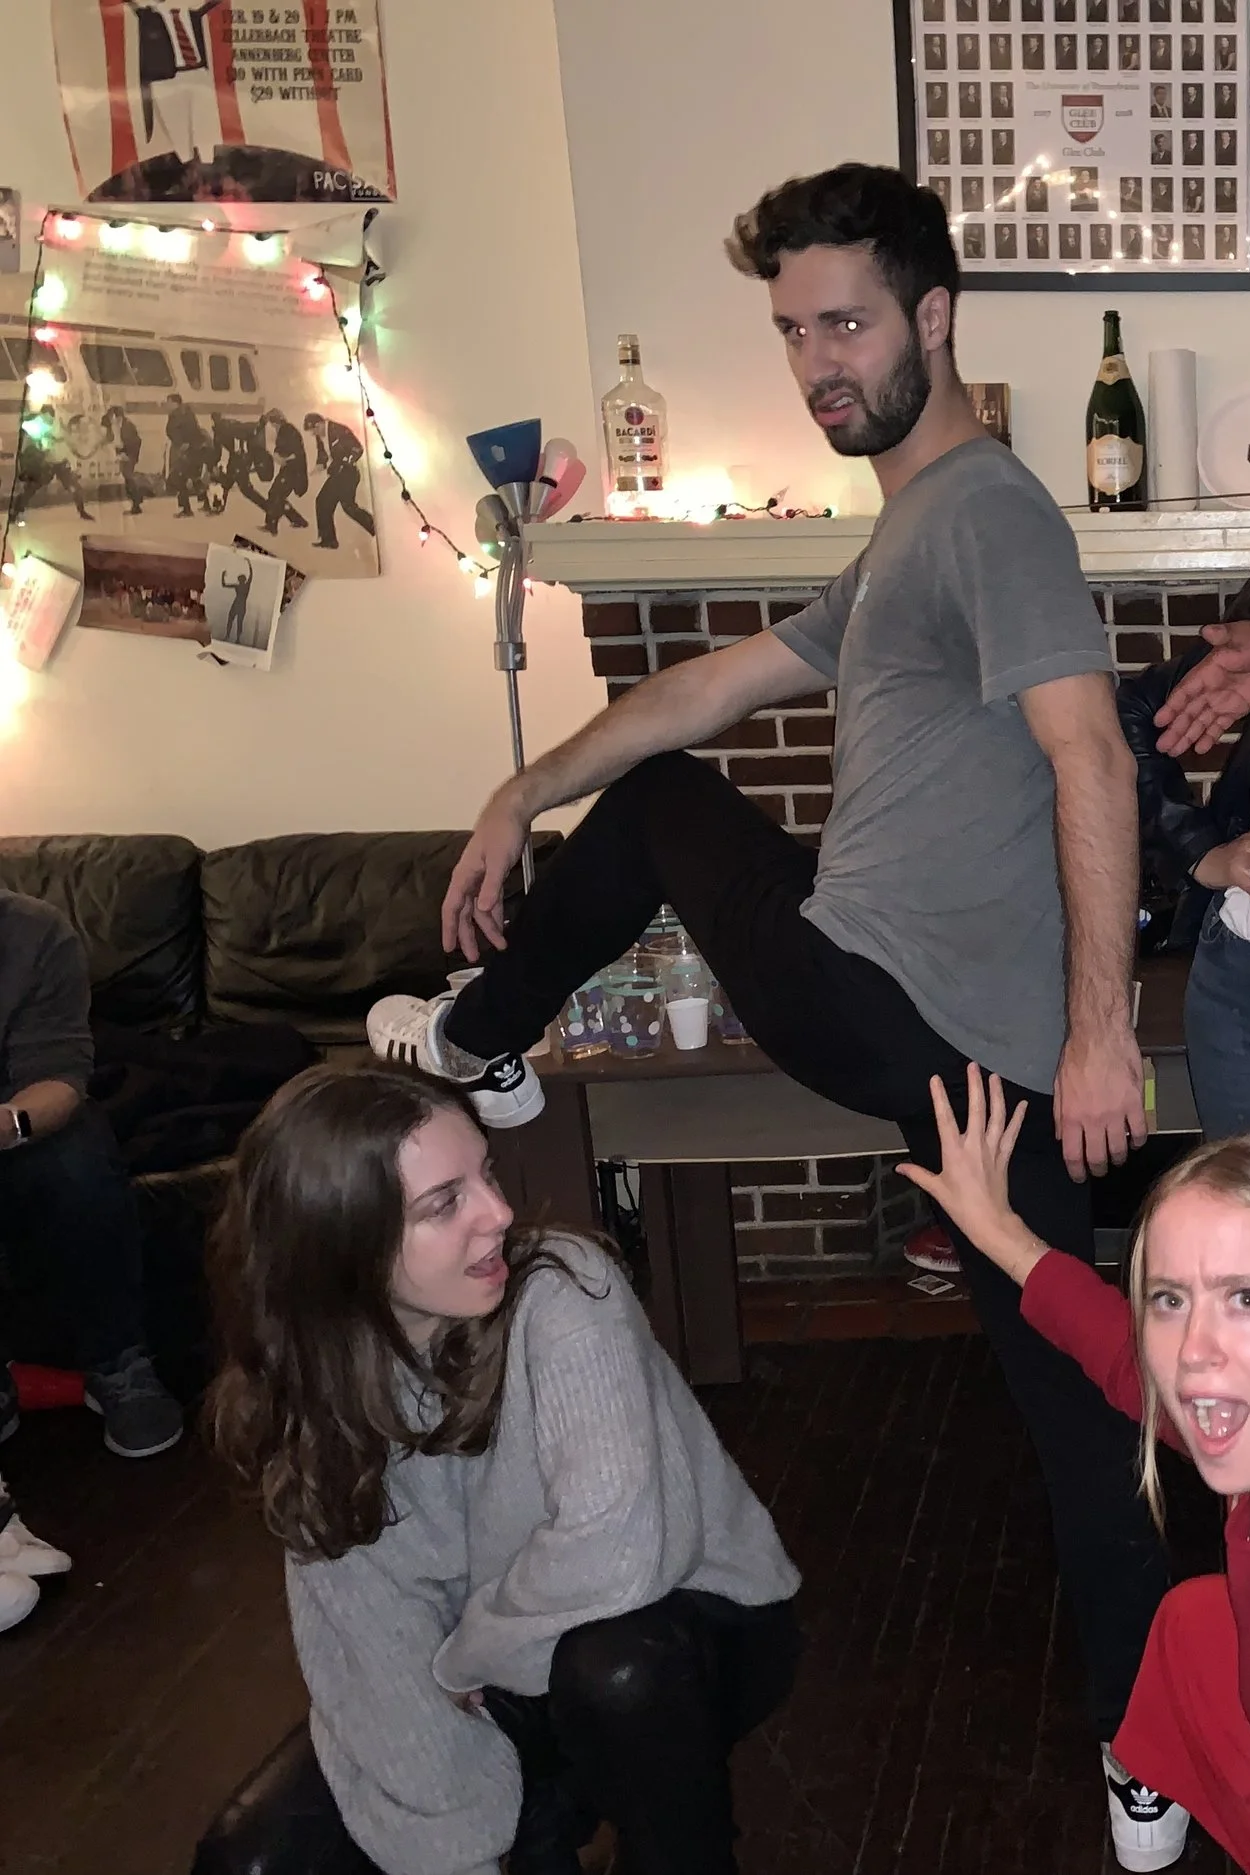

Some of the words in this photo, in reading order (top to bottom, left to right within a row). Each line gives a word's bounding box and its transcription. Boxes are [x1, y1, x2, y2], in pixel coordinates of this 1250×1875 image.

[335, 9, 357, 24] PM
[251, 67, 288, 81] WITH
[330, 68, 363, 82] CARD
[313, 170, 347, 193] PAC
[1130, 1805, 1159, 1814] adidas
